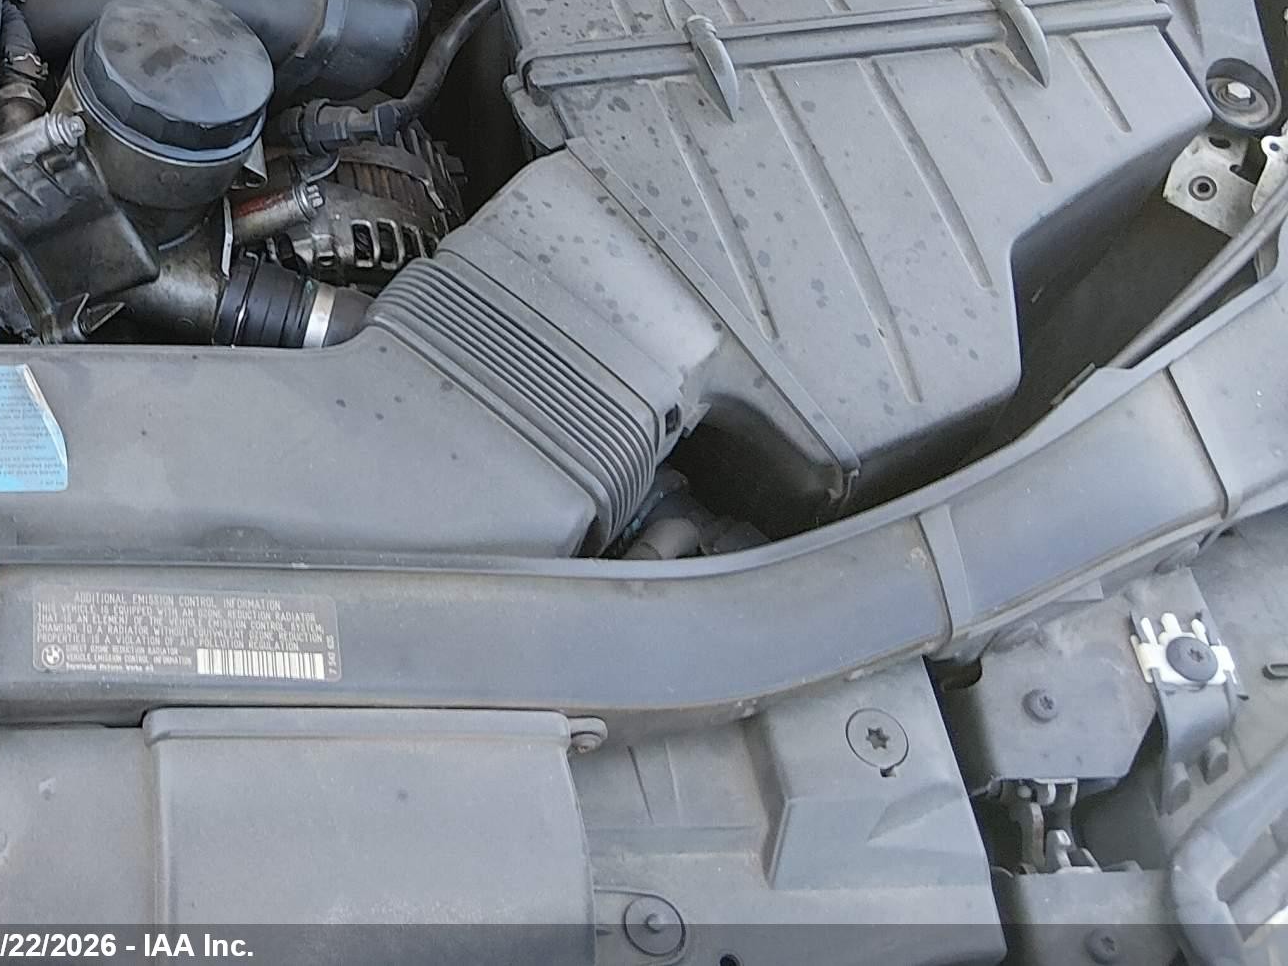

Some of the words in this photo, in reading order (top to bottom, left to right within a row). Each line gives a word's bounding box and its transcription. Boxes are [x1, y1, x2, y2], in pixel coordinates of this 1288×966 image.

[74, 592, 126, 605] ADDITIONAL
[132, 593, 175, 606] EMISSION
[178, 595, 218, 608] CONTROL
[223, 597, 282, 611] INFORMATION
[37, 612, 58, 624] THAT
[93, 614, 128, 626] ELEMENT
[149, 616, 164, 627] THE
[169, 617, 203, 629] VEHICLE
[207, 619, 247, 630] EMISSION
[251, 621, 285, 632] CONTROL
[62, 602, 97, 614] VEHICLE
[113, 604, 154, 616] EQUIPPED
[157, 606, 179, 617] WITH
[183, 607, 194, 618] AN
[198, 608, 223, 619] OZONE
[227, 609, 271, 621] REDUCTION
[275, 611, 317, 623] RADIATOR
[37, 623, 79, 634] CHANGING
[108, 625, 150, 636] RADIATOR
[153, 626, 189, 638] WITHOUT
[194, 628, 245, 640] EQUIVALENT
[249, 631, 274, 642] OZONE
[278, 632, 323, 644] REDUCTION
[37, 633, 87, 644] PROPERTIES
[116, 635, 161, 647] VIOLATION
[164, 637, 175, 647] OF
[179, 637, 196, 648] AIR
[199, 638, 245, 649] POLLUTION
[248, 639, 300, 651] REGULATION
